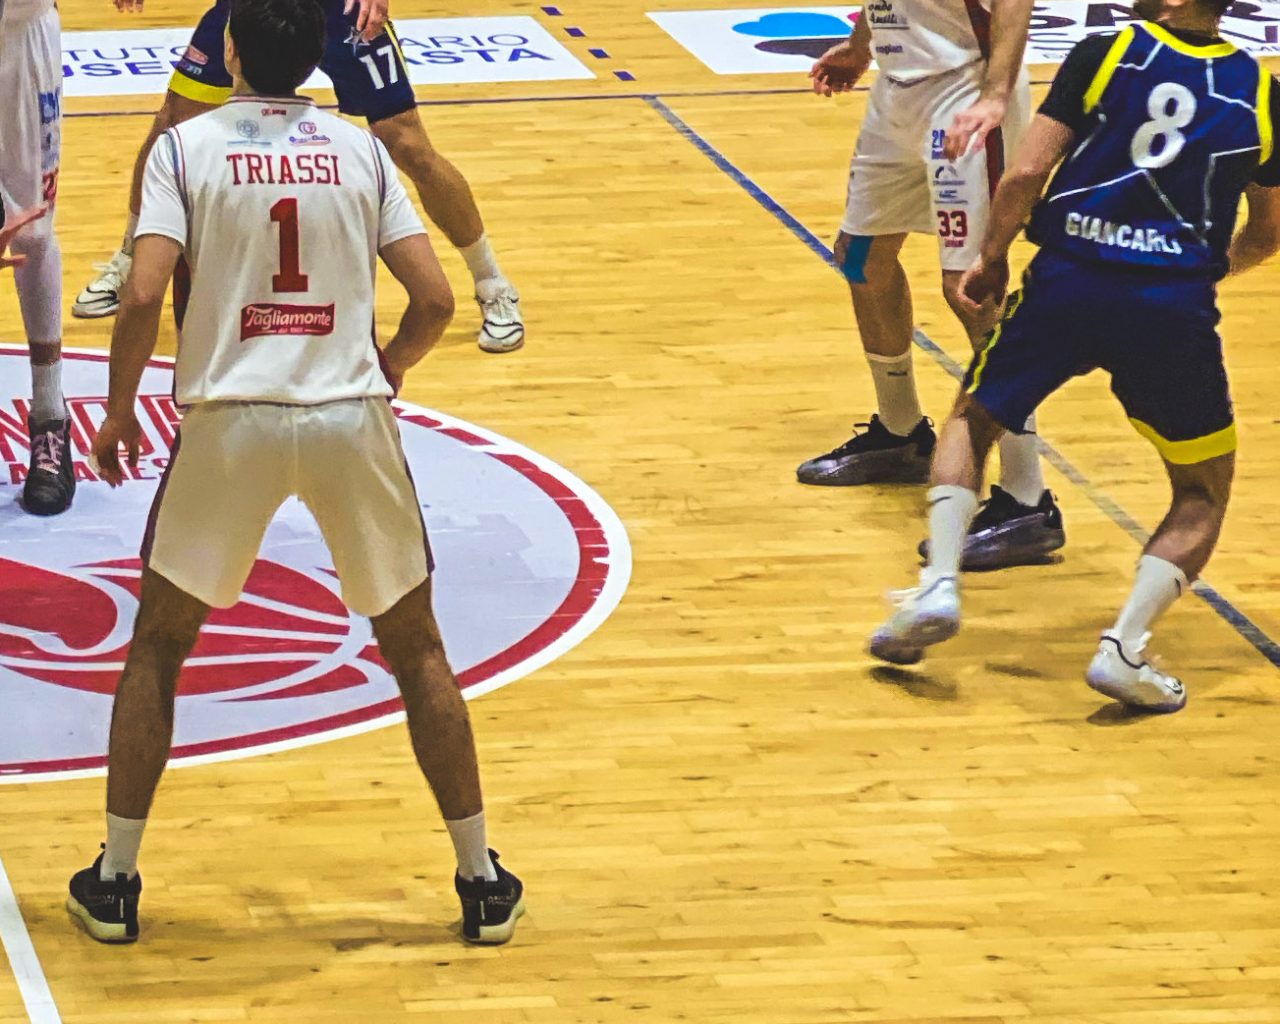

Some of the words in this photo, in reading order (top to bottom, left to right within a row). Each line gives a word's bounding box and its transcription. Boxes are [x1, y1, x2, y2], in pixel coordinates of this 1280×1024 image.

[358, 44, 399, 90] 17
[1130, 81, 1198, 169] 8
[226, 153, 341, 186] TRIASSI
[937, 210, 968, 237] 33
[270, 197, 308, 293] 1
[245, 305, 332, 331] Tagliamonte
